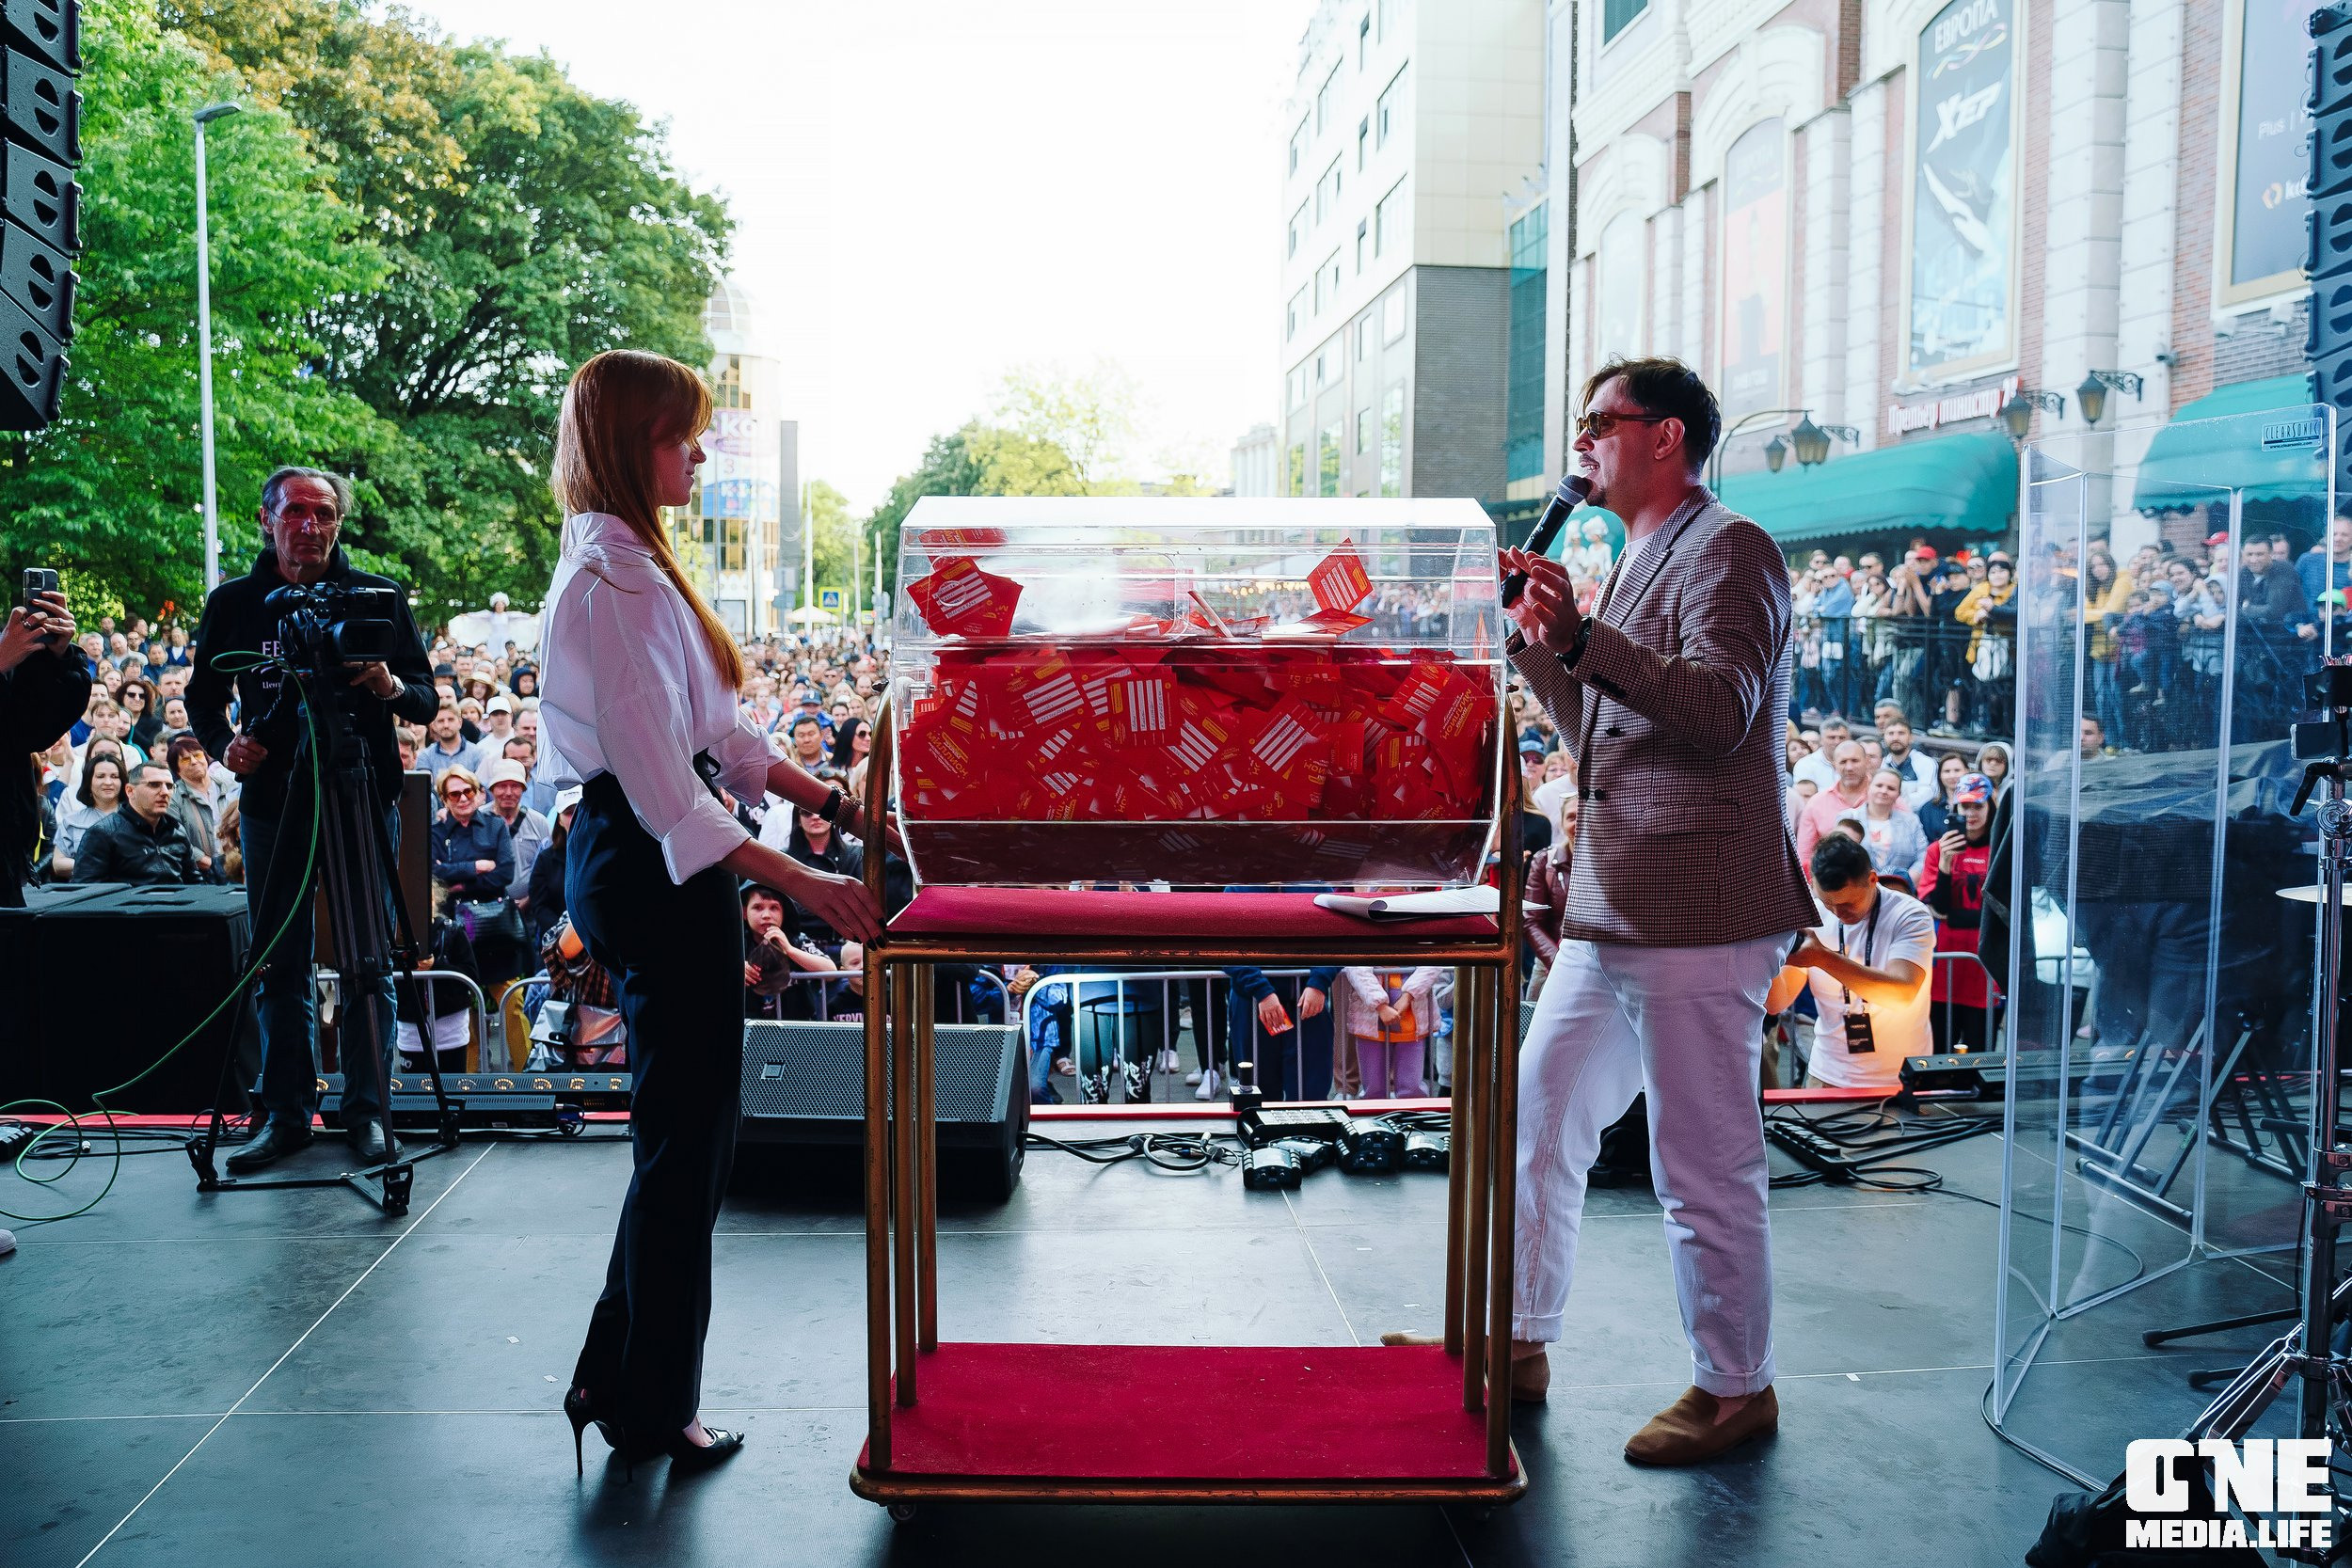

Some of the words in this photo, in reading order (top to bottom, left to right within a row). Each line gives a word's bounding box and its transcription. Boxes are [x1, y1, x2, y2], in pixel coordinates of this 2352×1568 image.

[1934, 0, 2000, 55] ЕВРОПА
[2265, 421, 2319, 440] CLEARSONIC
[926, 730, 969, 778] МИЛЛИОН
